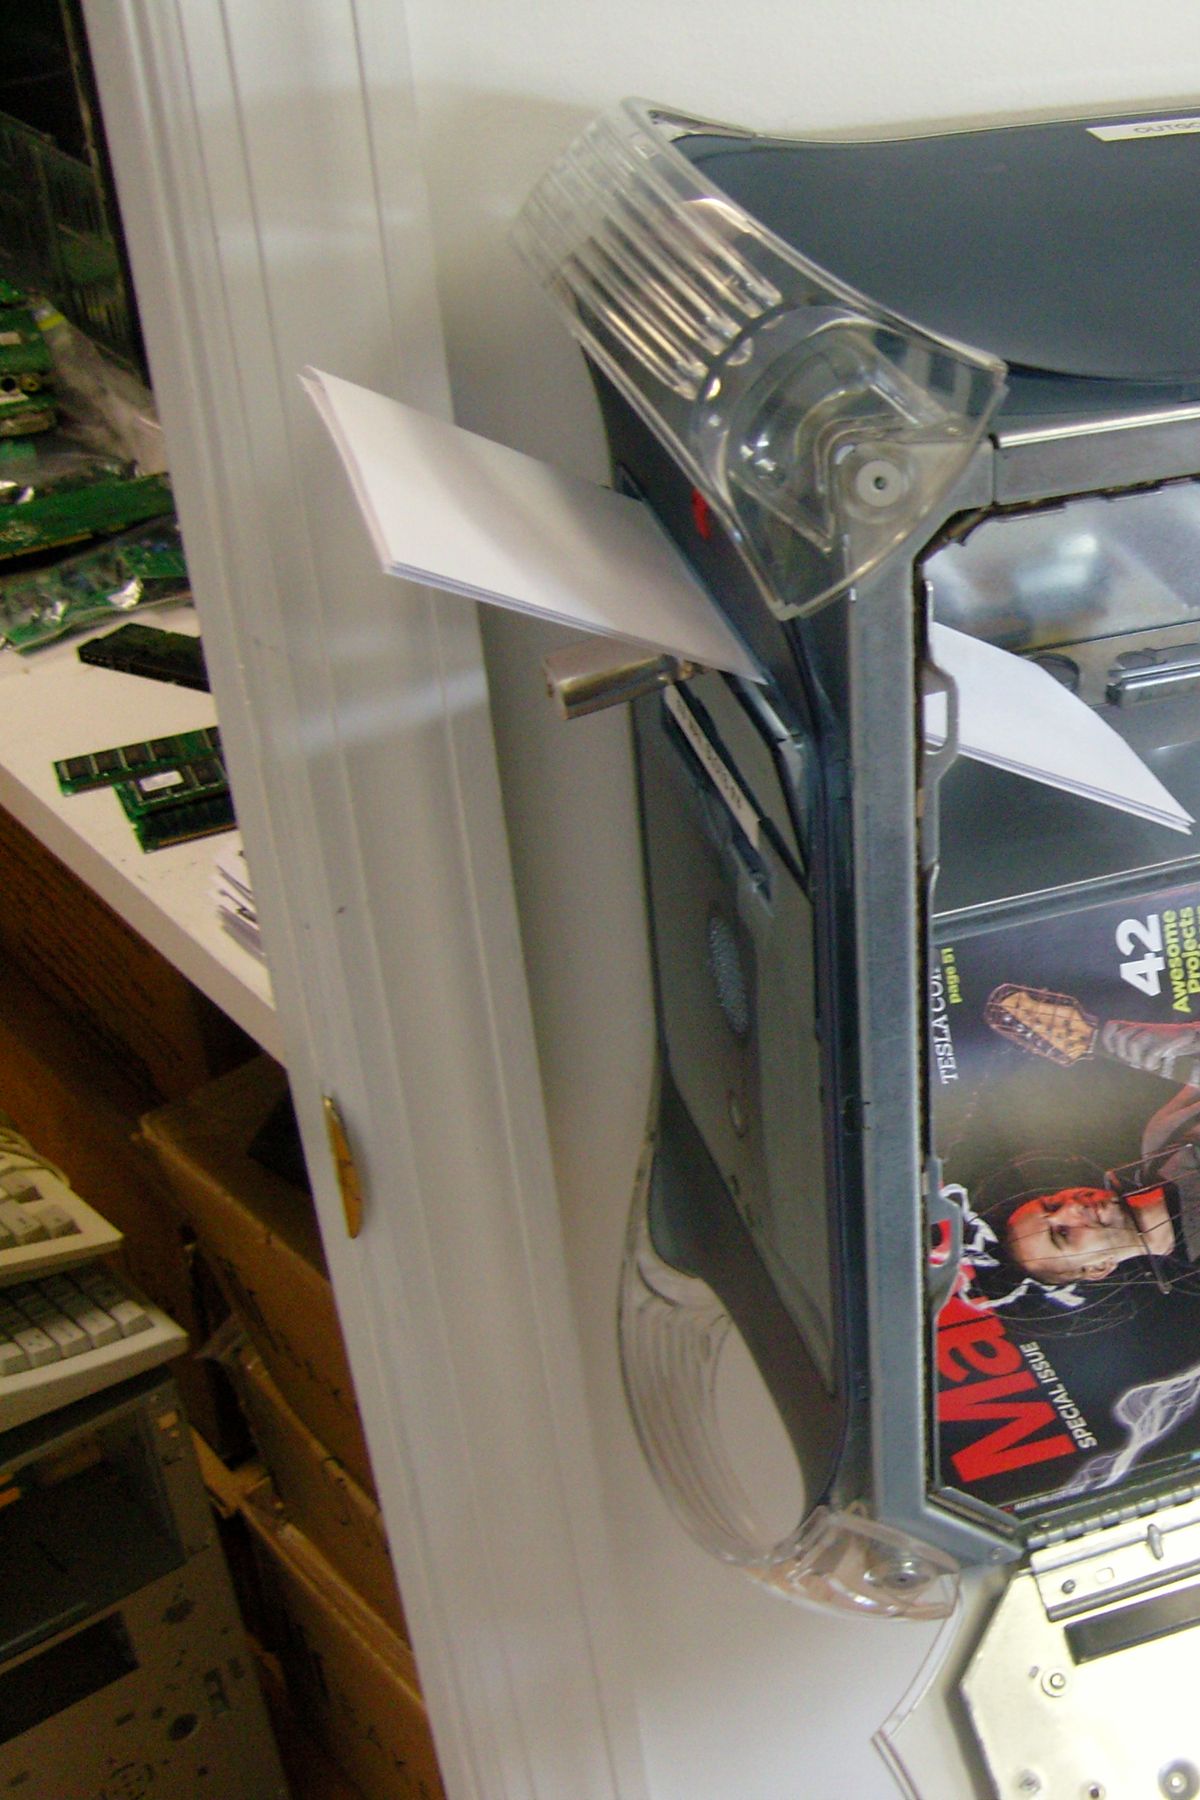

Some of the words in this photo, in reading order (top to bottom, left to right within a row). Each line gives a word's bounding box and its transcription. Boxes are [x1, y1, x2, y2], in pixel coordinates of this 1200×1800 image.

[941, 947, 956, 964] 51
[945, 965, 964, 1005] page
[1115, 913, 1165, 997] 42
[1162, 909, 1192, 1013] Awesome
[931, 1013, 960, 1086] TESLA
[930, 1219, 1077, 1482] Ma
[1019, 1340, 1059, 1384] ISSUE
[1048, 1382, 1099, 1449] SPECIAL
